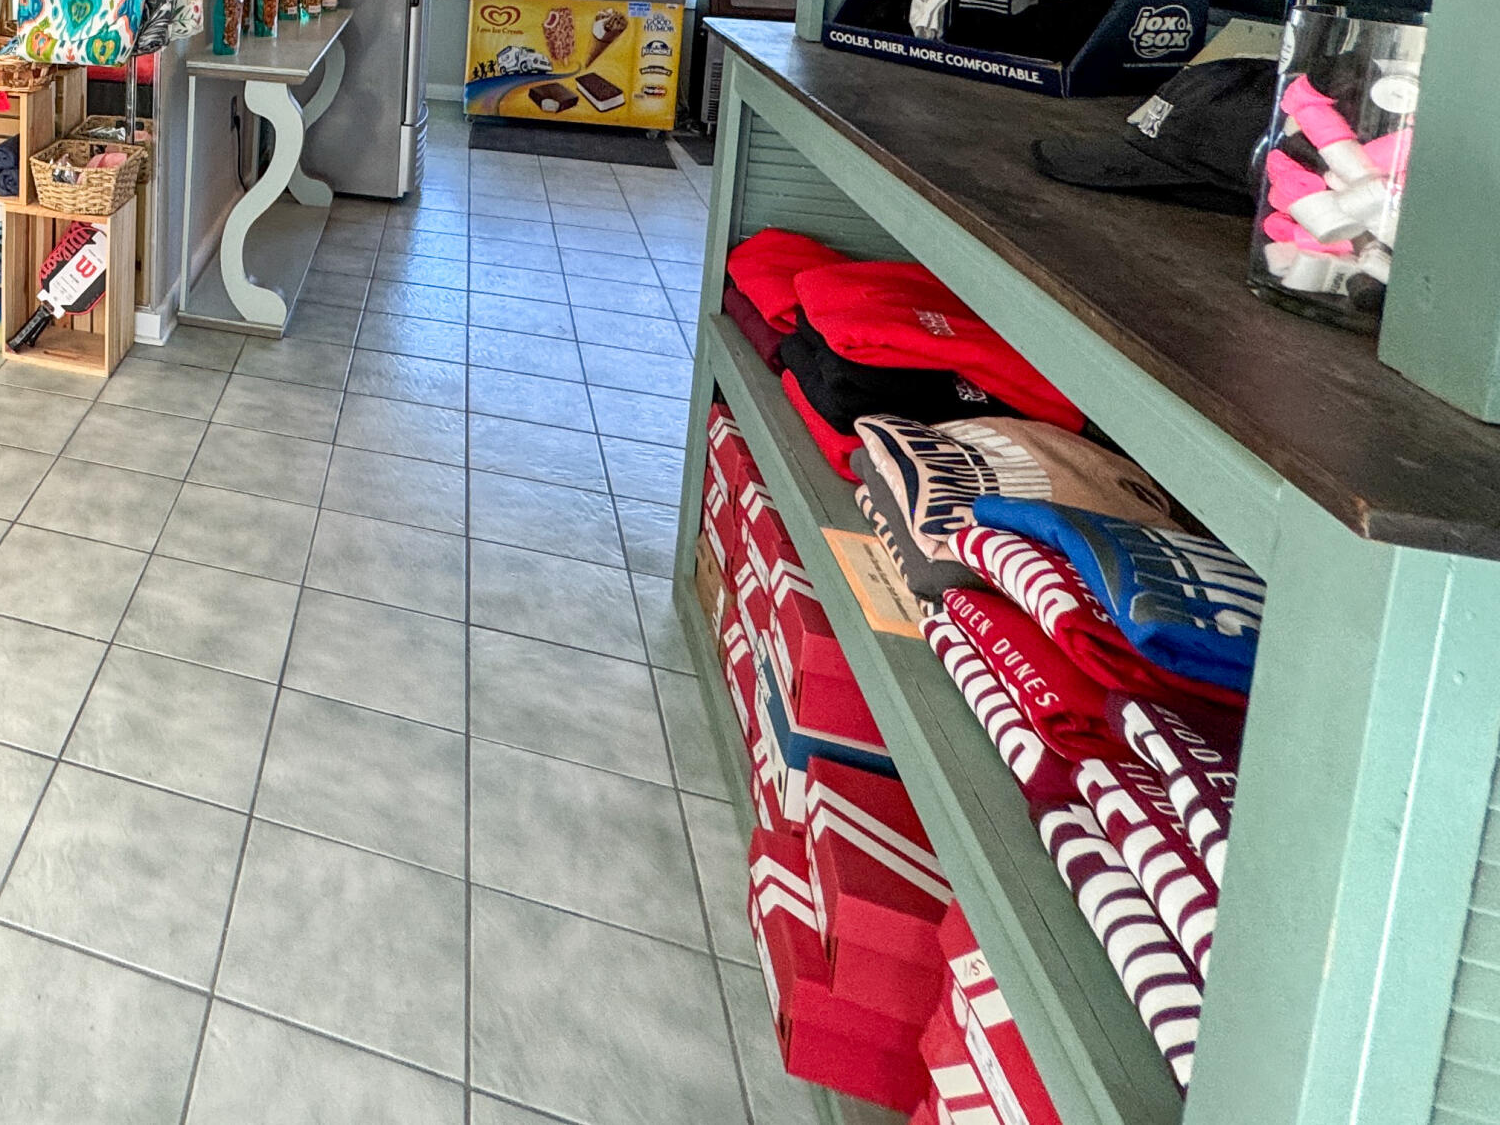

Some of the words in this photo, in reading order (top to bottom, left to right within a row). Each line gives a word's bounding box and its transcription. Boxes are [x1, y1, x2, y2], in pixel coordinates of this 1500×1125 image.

[1134, 11, 1178, 36] jox
[1139, 32, 1188, 47] sox
[829, 30, 872, 49] COOLER.
[874, 39, 907, 57] DRIER.
[909, 45, 944, 63] MORE
[945, 53, 1044, 85] COMFORTABLE.
[75, 254, 98, 278] W
[991, 637, 1060, 708] DUNES
